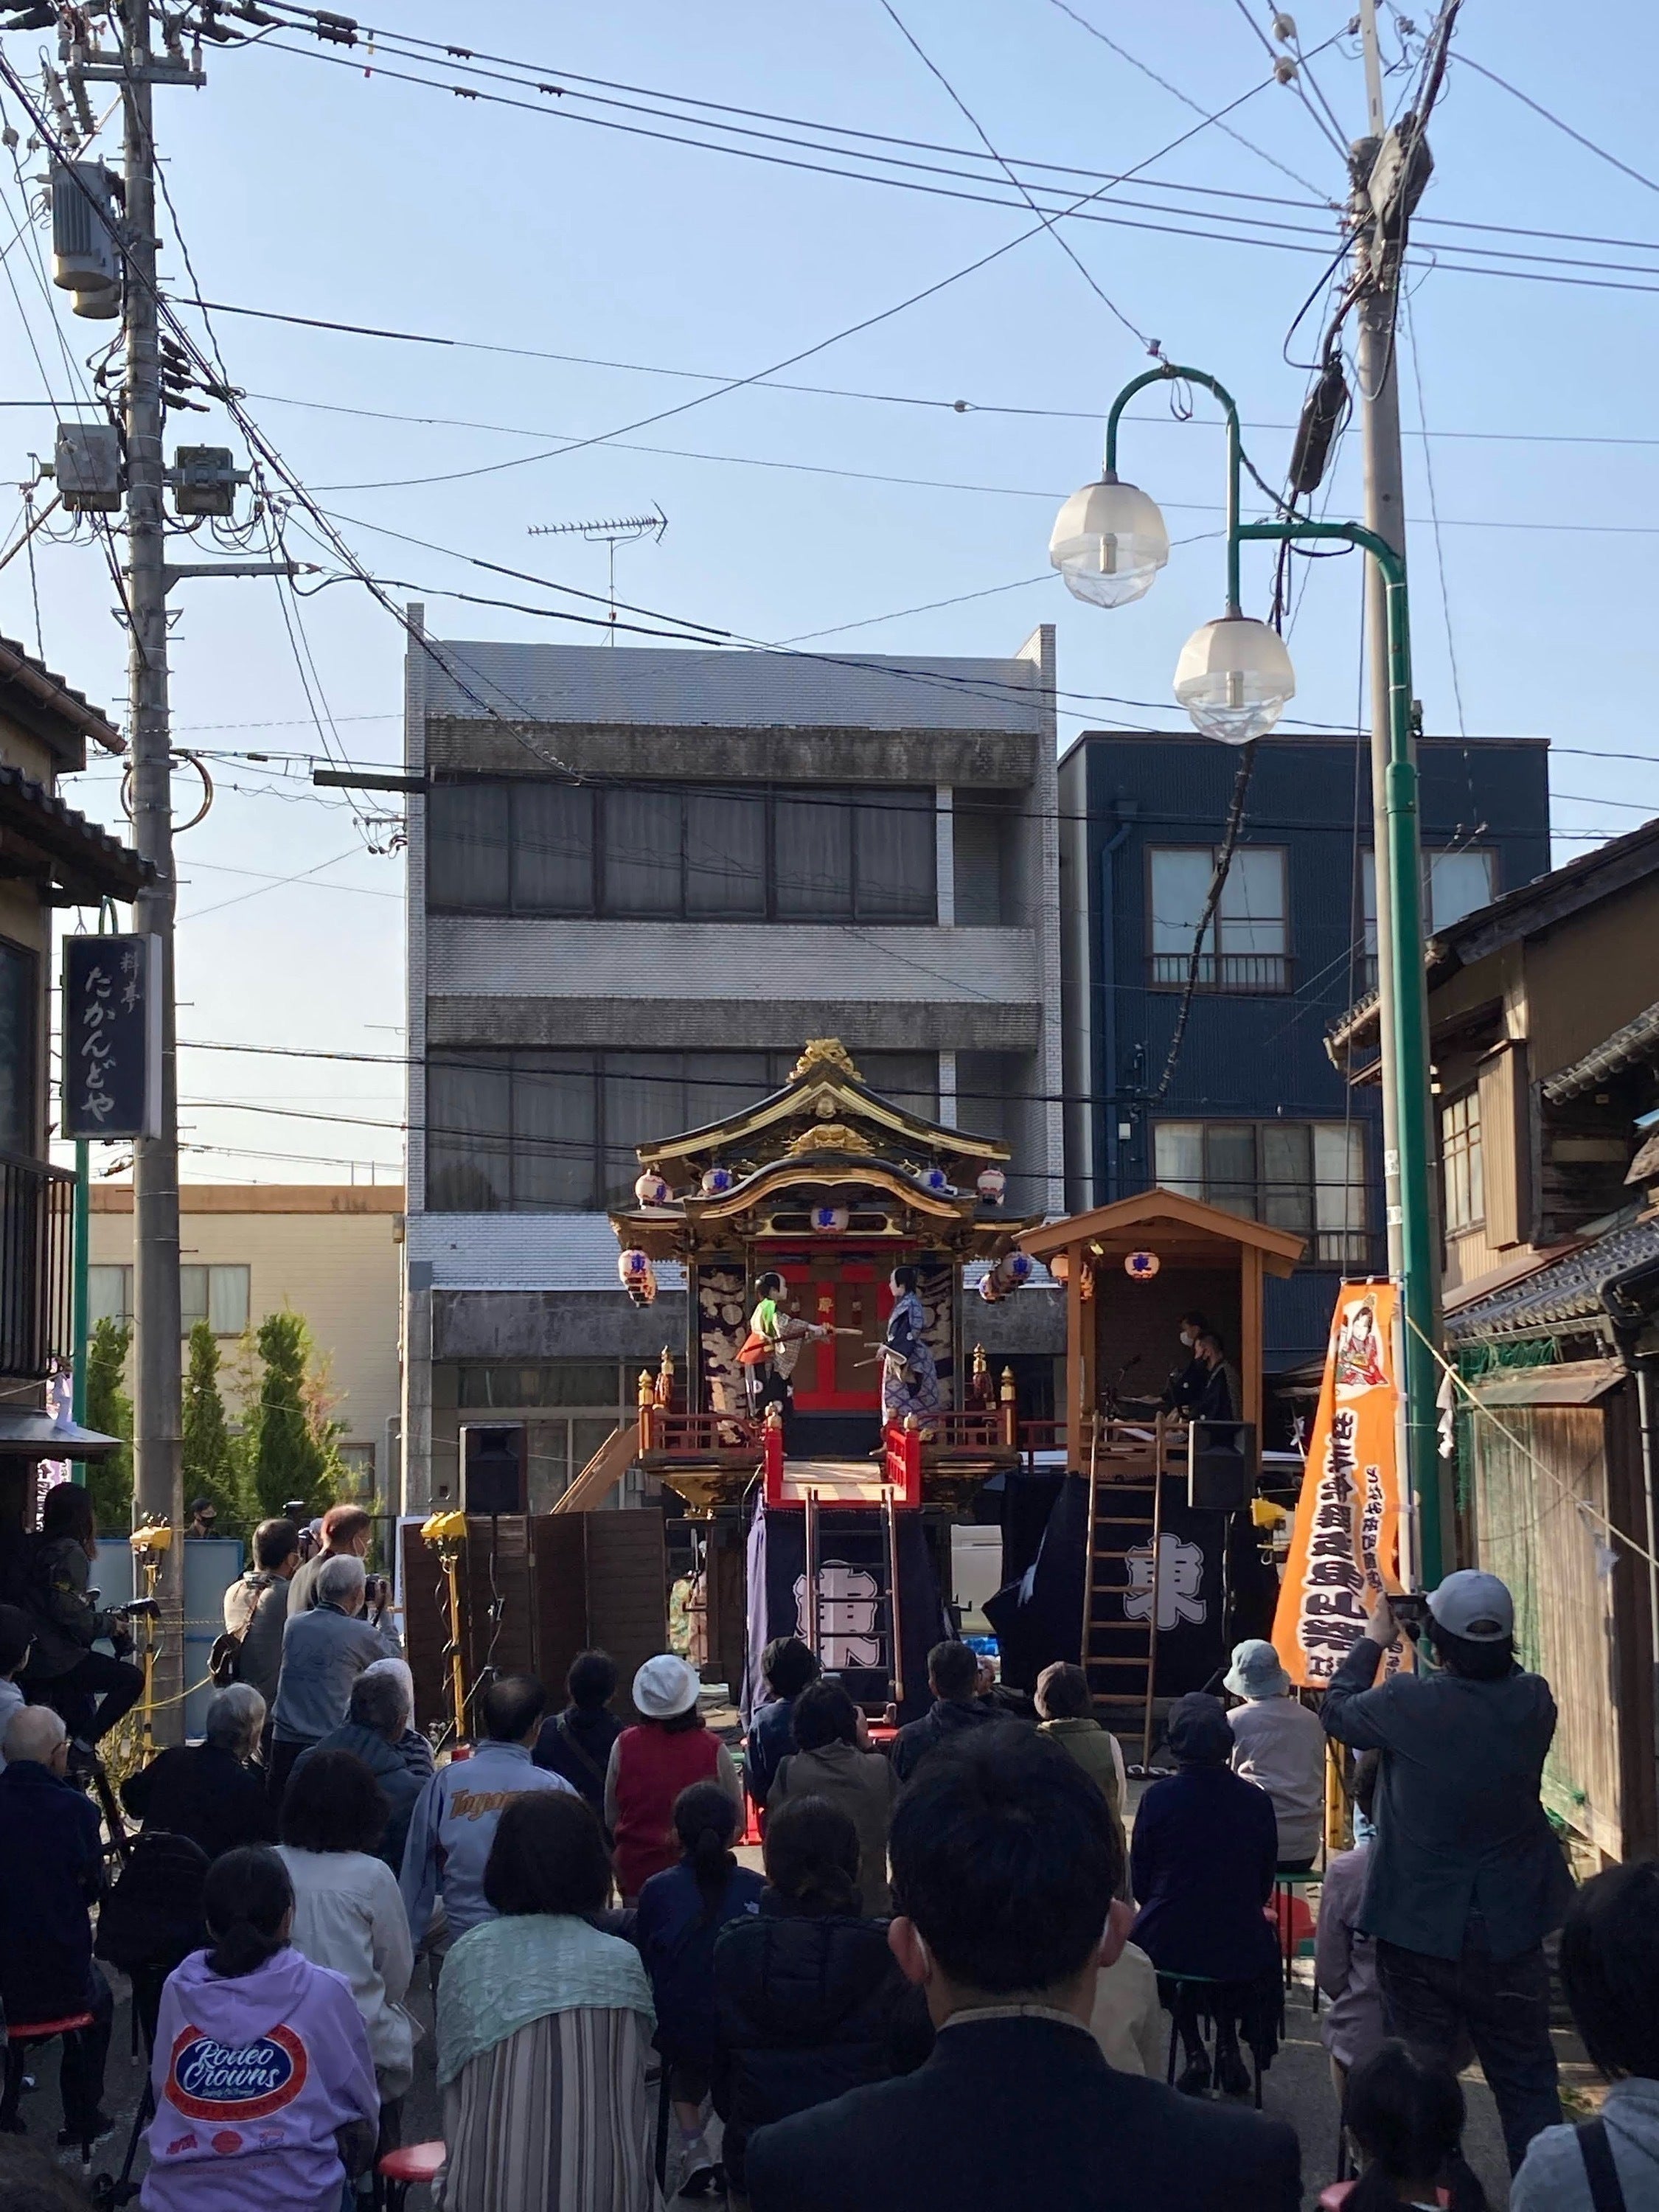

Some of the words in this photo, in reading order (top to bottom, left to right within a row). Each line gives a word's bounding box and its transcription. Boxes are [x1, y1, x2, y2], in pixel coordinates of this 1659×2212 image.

[120, 951, 140, 1014] 料亭
[1124, 1534, 1206, 1630] 東
[183, 2060, 281, 2091] Crowns
[195, 2040, 274, 2070] Rodeo
